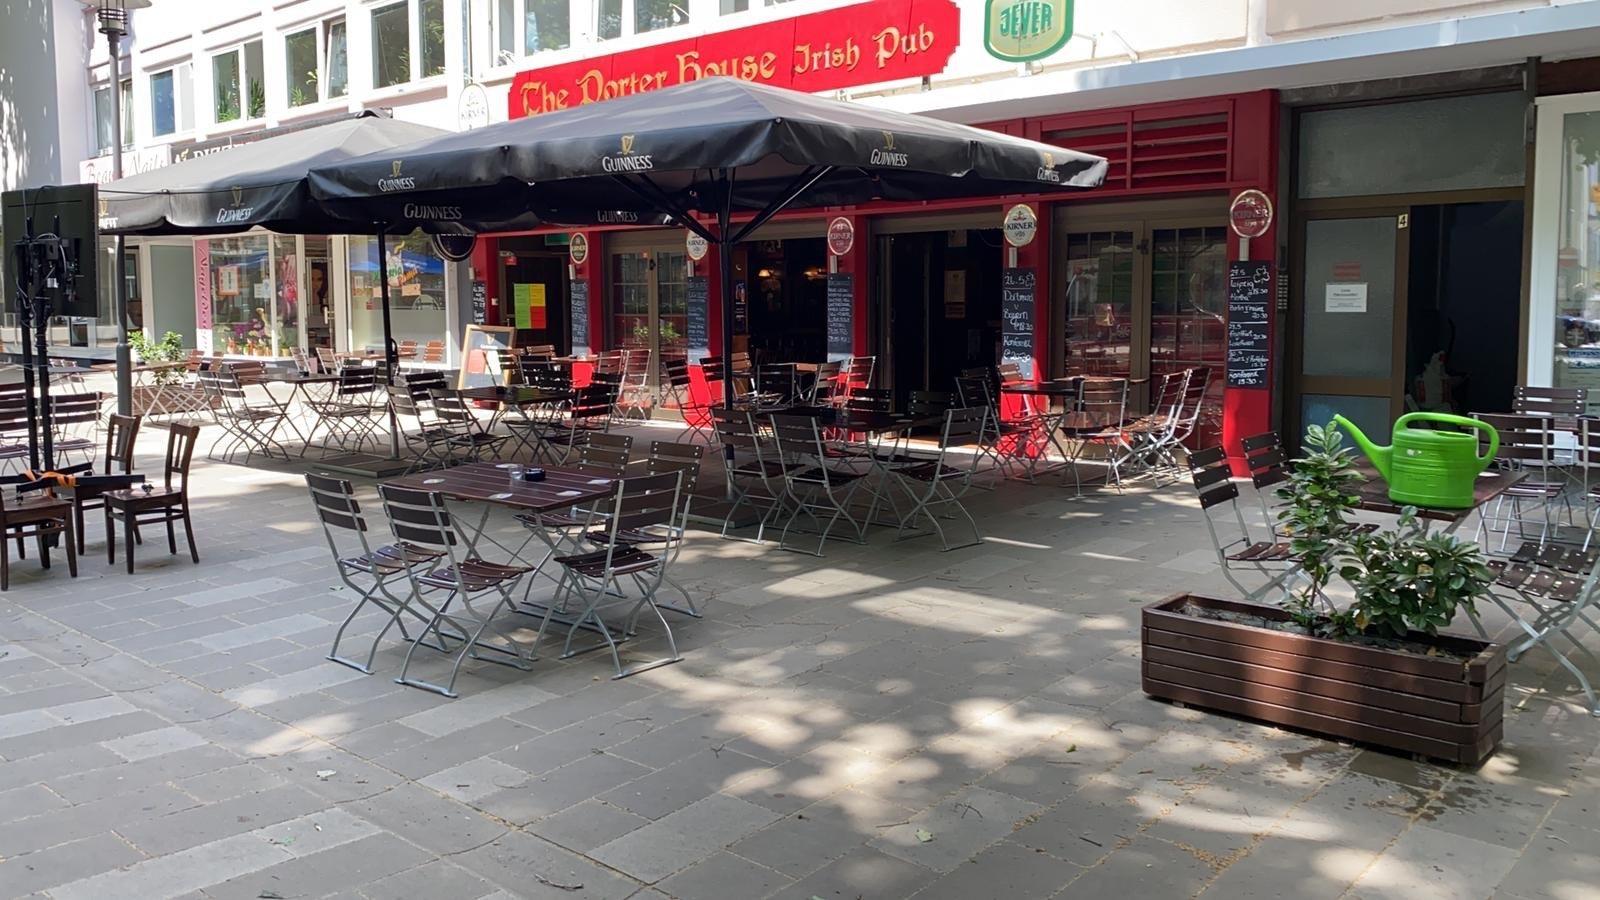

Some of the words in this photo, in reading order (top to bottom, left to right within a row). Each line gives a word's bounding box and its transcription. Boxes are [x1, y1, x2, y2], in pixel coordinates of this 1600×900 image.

[1000, 2, 1053, 38] JEVER
[520, 81, 569, 118] The
[576, 69, 668, 105] Porter
[675, 50, 777, 84] House
[794, 37, 860, 74] Irish
[871, 22, 935, 69] Pub
[602, 154, 654, 172] GUINNESS
[870, 148, 908, 167] GUINNESS
[378, 176, 416, 192] GUINNESS
[404, 203, 463, 220] GUINNESS
[1006, 221, 1033, 231] KIRNER
[1399, 215, 1407, 227] 4
